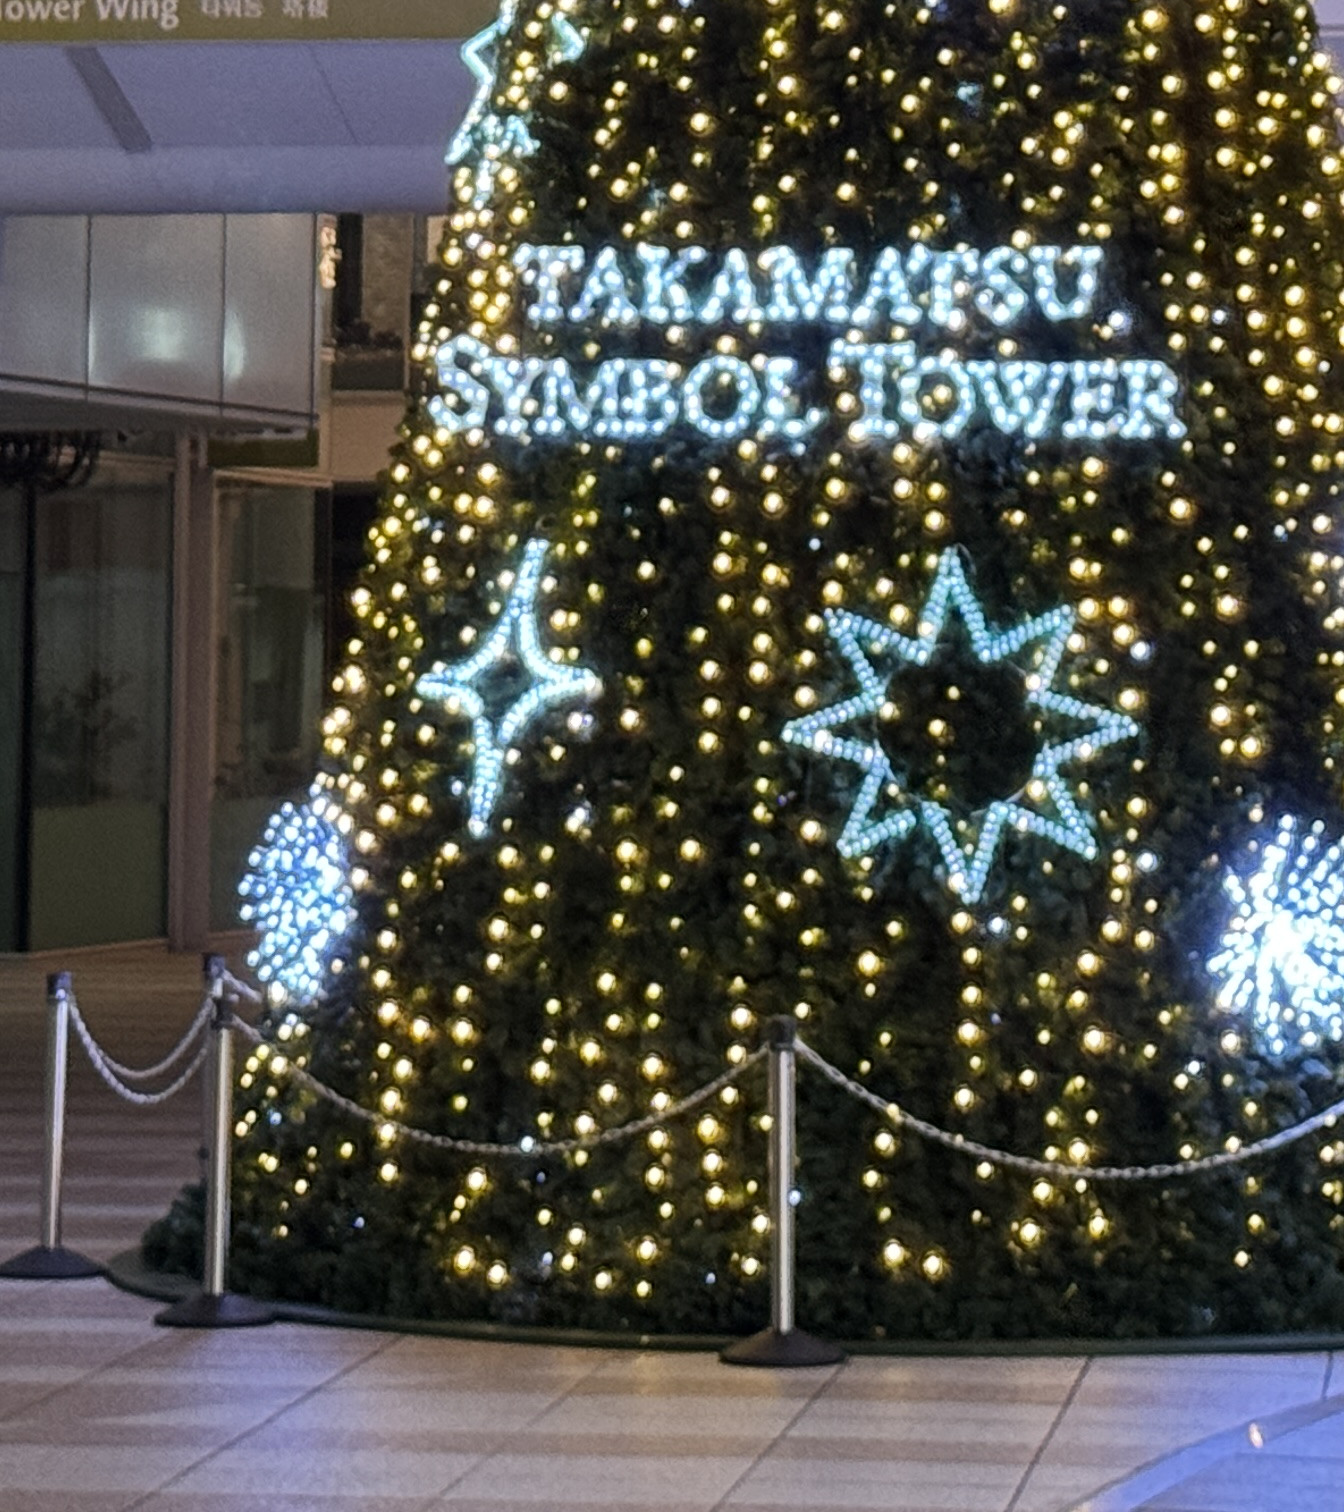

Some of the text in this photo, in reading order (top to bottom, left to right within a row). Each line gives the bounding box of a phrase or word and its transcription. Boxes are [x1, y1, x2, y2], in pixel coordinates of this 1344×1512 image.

[512, 243, 1103, 325] TAKAMATSU
[427, 332, 1189, 442] SYMBOL TOWER
